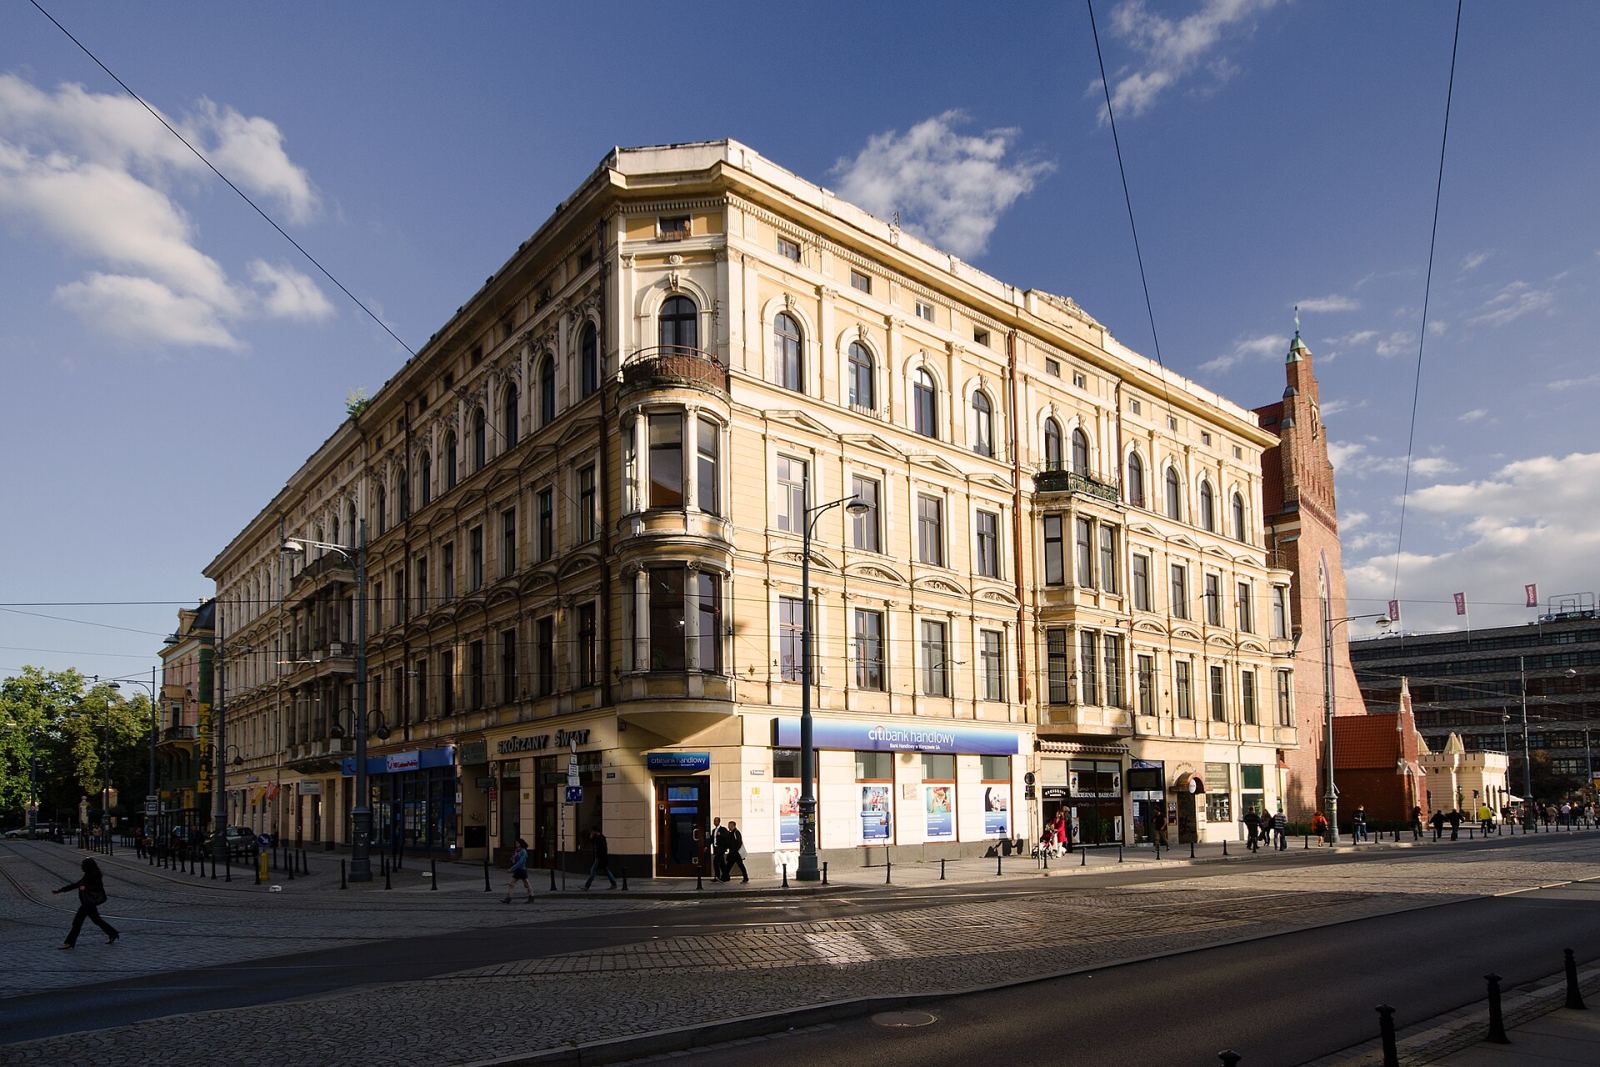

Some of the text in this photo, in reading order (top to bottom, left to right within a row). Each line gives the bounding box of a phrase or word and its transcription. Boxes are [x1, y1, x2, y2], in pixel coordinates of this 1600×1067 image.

[497, 729, 590, 753] SKÓRZANY ŚWIAT
[868, 727, 955, 747] citibank handlowy
[676, 756, 706, 764] handlowy
